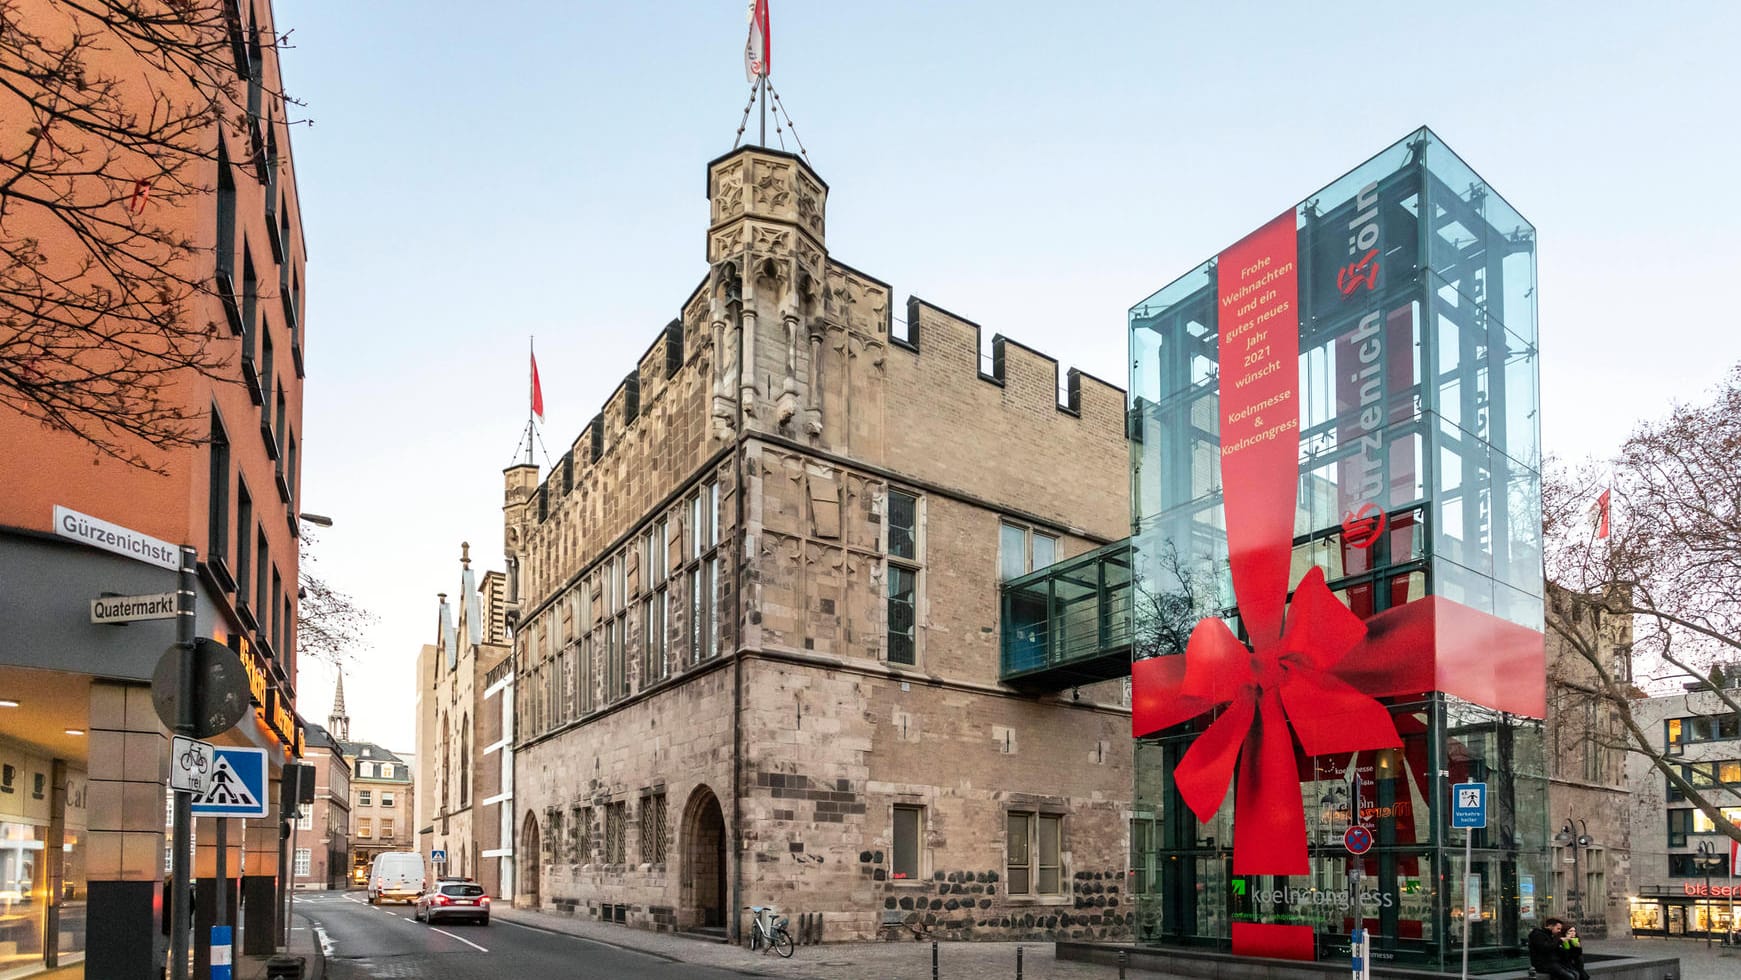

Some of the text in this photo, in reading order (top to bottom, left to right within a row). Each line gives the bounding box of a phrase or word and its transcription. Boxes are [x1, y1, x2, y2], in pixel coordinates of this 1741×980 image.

[1241, 256, 1271, 280] Frohe
[1222, 262, 1293, 307] Weihnachten
[1237, 289, 1277, 317] und ein
[1226, 301, 1289, 344] gutes neues
[1246, 330, 1268, 350] Jahr
[1244, 345, 1271, 368] 2021
[1235, 360, 1281, 389] wünscht
[1228, 390, 1292, 425] Koelnmesse
[1254, 416, 1264, 428] &
[1341, 310, 1386, 550] Gürzenich
[1222, 418, 1298, 457] Koelncongress
[62, 514, 176, 565] Gürzenichstr.
[94, 597, 174, 619] Quatermarkt
[188, 774, 202, 789] frei
[1684, 882, 1741, 897] blaser
